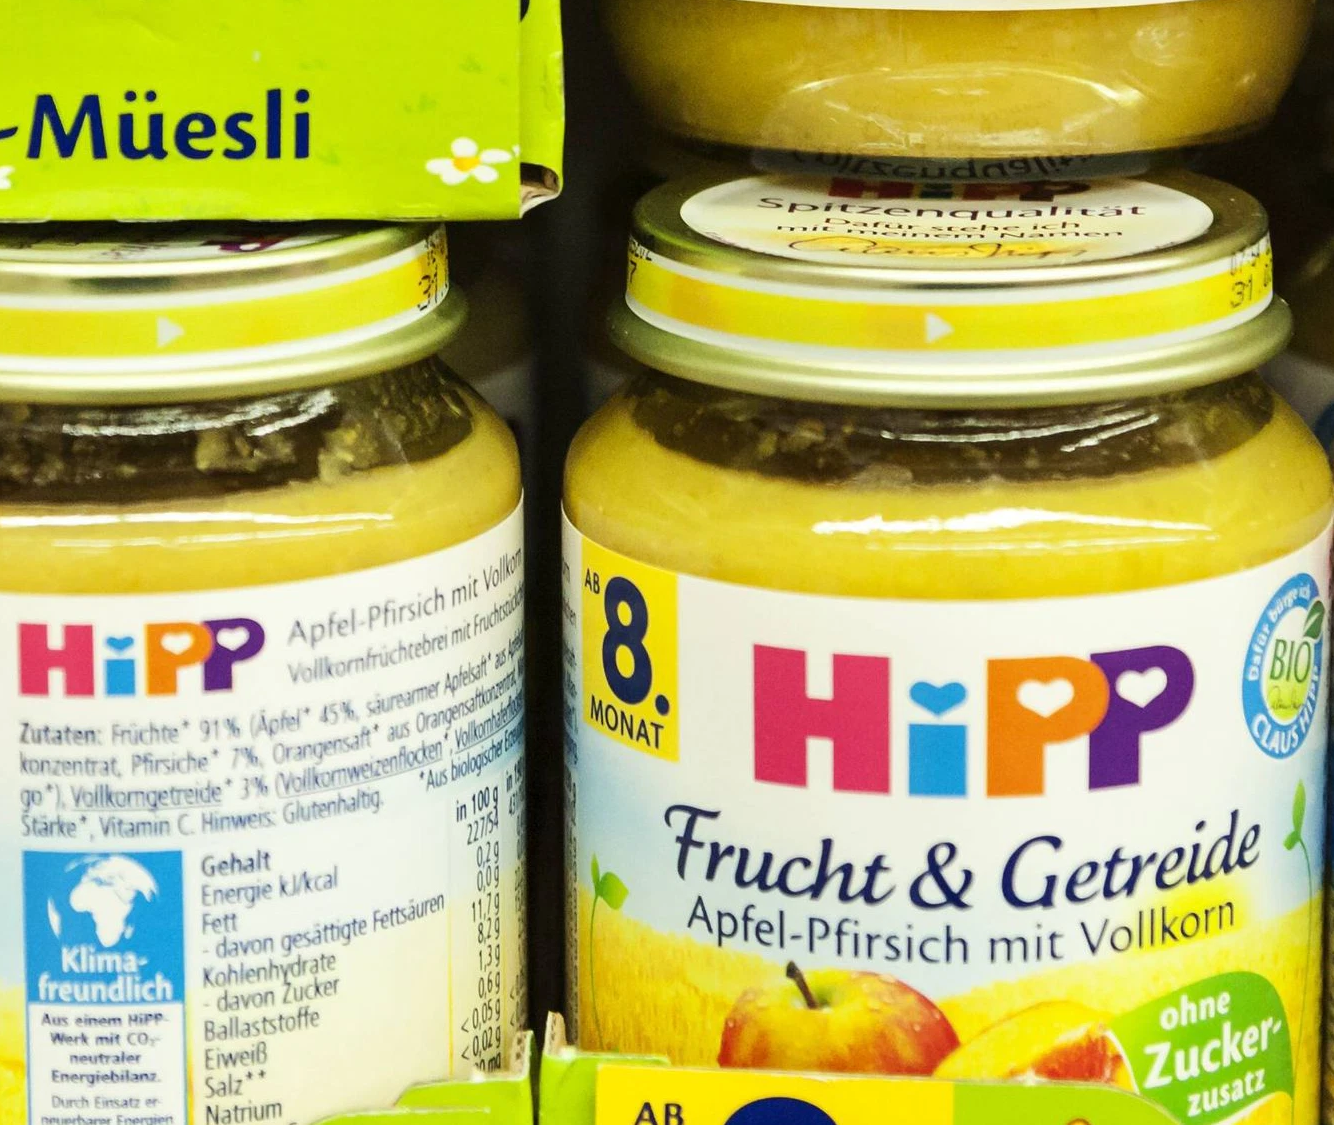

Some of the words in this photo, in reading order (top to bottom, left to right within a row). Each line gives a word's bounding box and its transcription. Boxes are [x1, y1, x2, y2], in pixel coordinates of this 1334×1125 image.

[756, 196, 1147, 222] Spitzenqualität
[287, 586, 446, 649] Apfel-Pfirsich
[451, 575, 479, 609] mit
[482, 547, 523, 592] Vollkorn
[584, 567, 601, 596] AB
[18, 617, 265, 698] HiPP
[287, 631, 449, 685] Vollkornfrüchtebrei
[601, 576, 671, 718] 8.
[1269, 638, 1312, 684] BIO
[590, 693, 665, 752] MONAT
[752, 643, 1197, 800] HiPP
[1252, 712, 1299, 755] CLAUS
[664, 804, 896, 903] Frucht
[909, 841, 974, 913] &
[1001, 809, 1262, 911] Getreide
[686, 894, 969, 966] Apfel-Pfirsich
[988, 915, 1064, 964] mit
[1080, 899, 1236, 956] Vollkorn
[60, 945, 149, 974] Klima-
[37, 970, 174, 1004] freundlich
[1160, 991, 1232, 1031] ohne
[1143, 1014, 1283, 1090] Zucker-
[1187, 1068, 1266, 1118] zusatz
